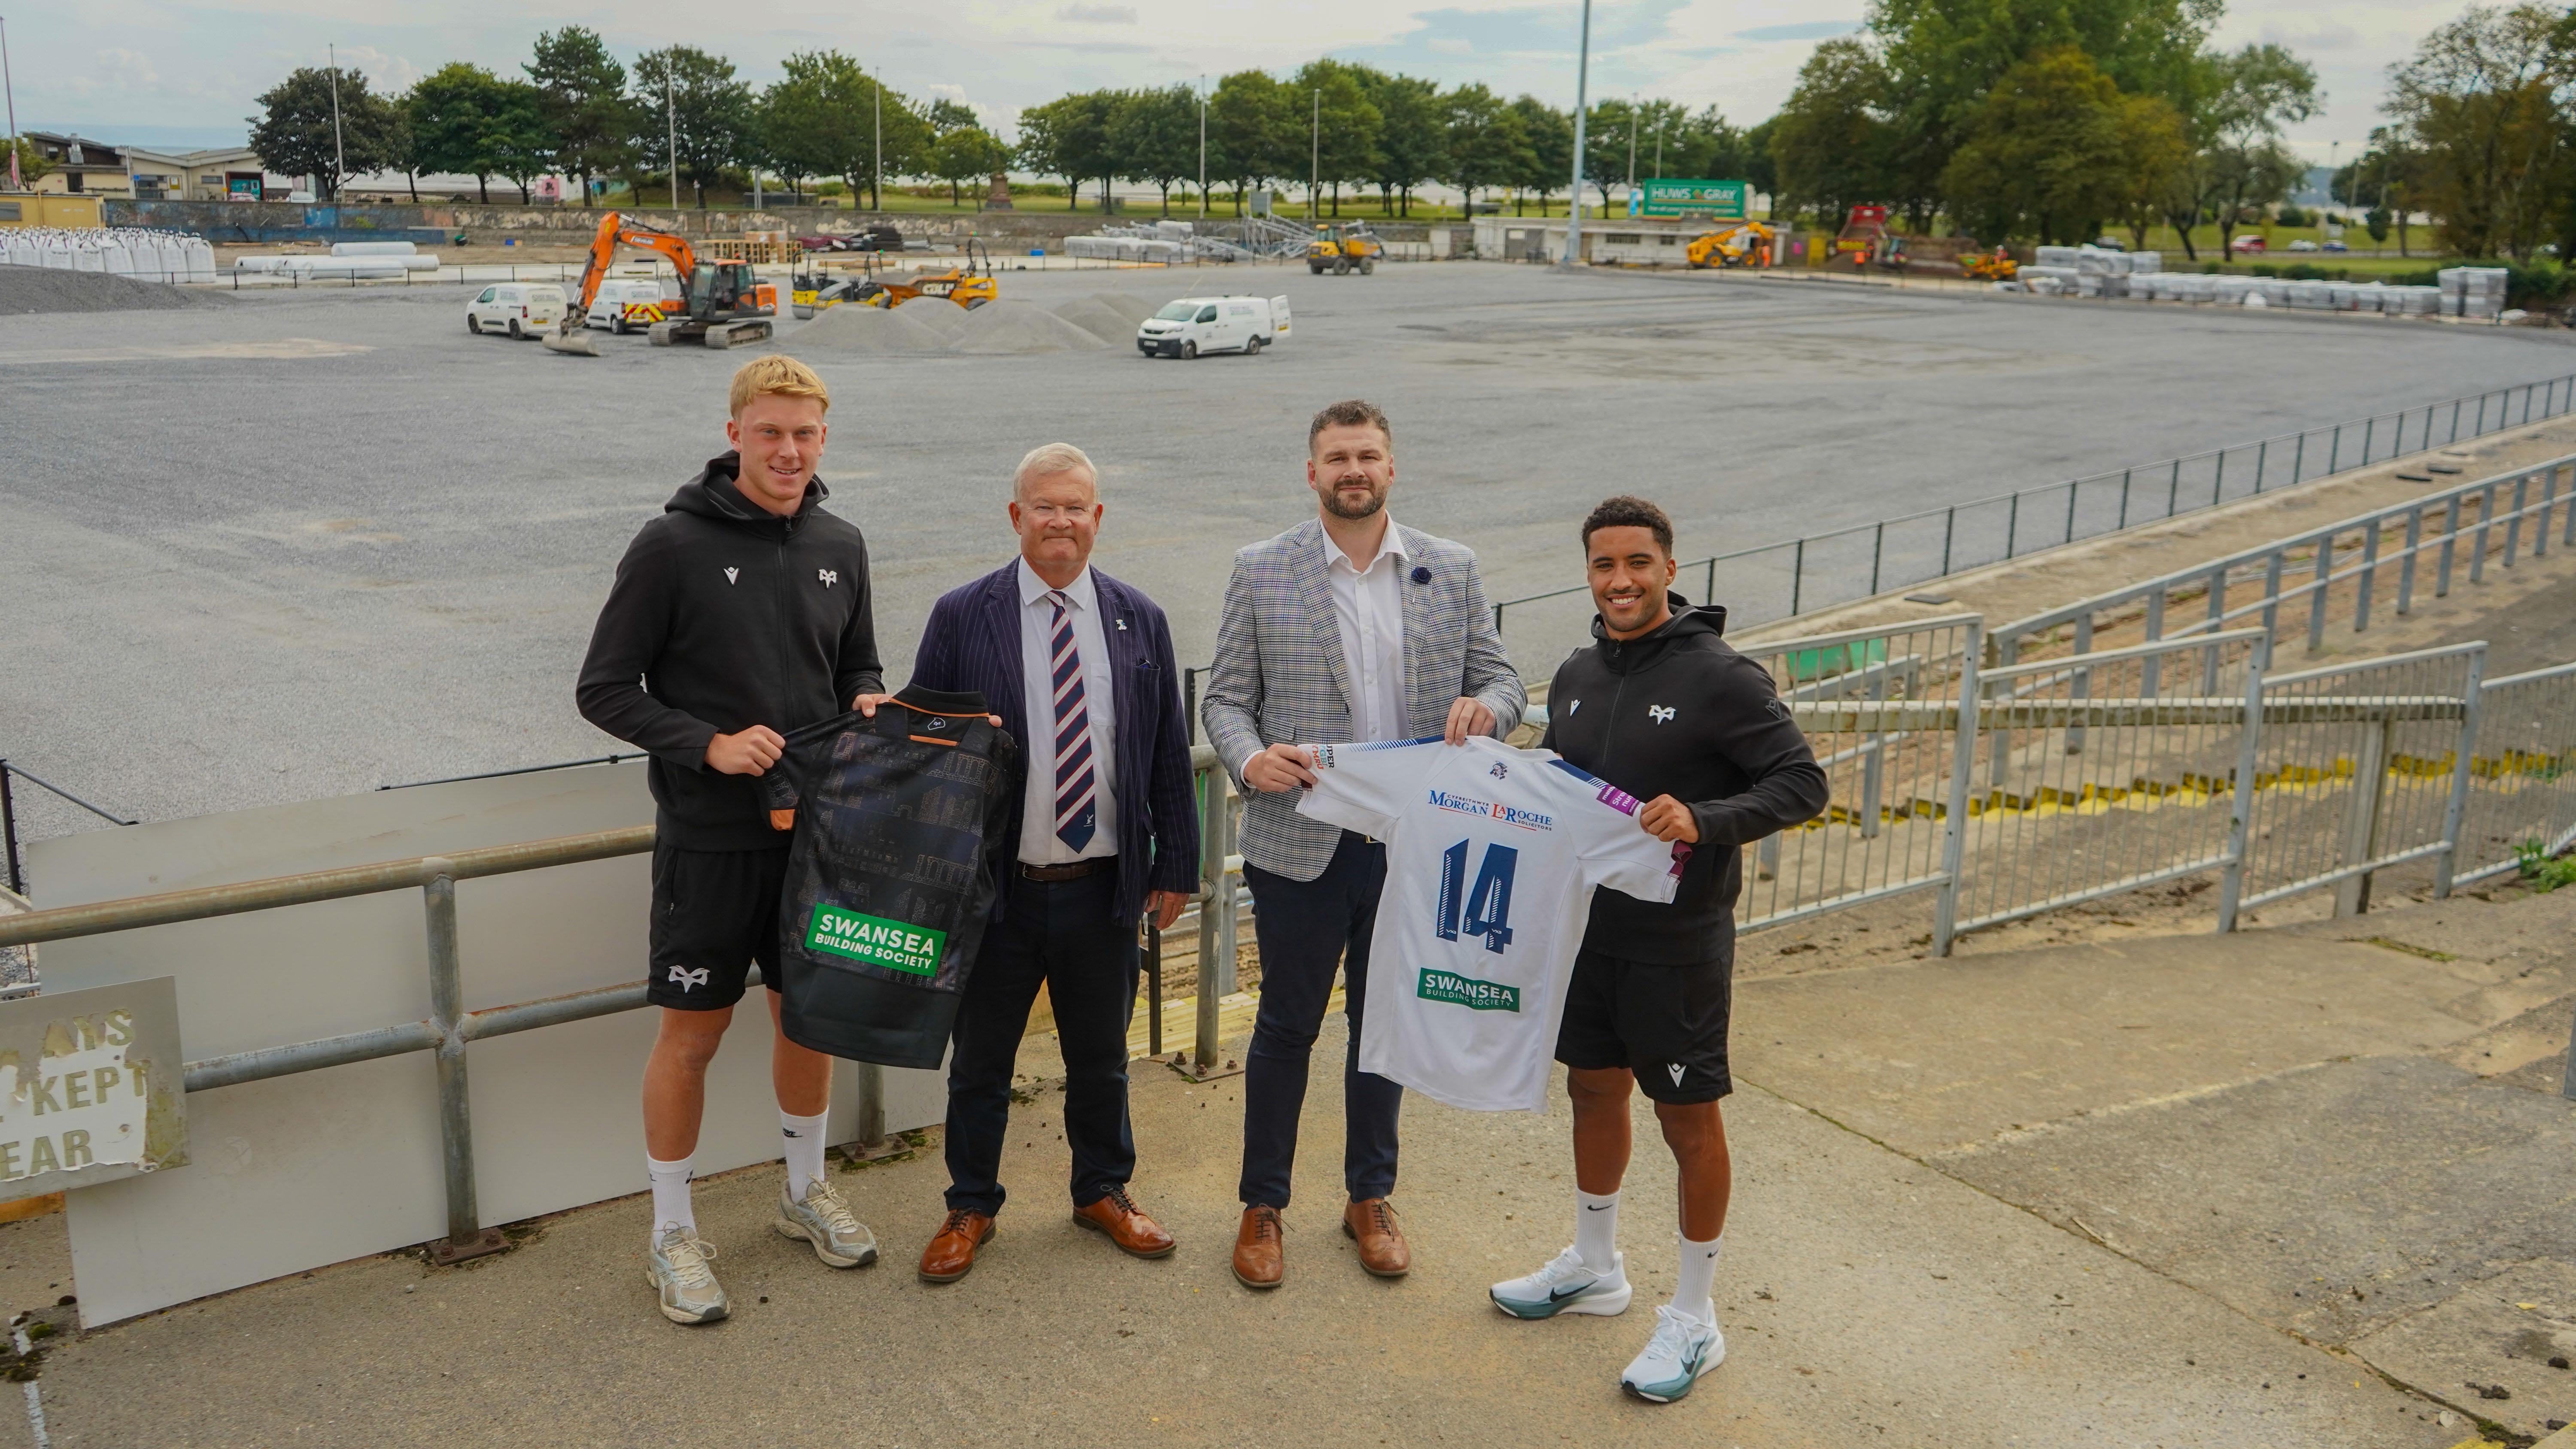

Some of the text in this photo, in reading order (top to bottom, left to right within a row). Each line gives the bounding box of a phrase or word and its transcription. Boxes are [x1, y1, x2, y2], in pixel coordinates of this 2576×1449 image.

[1653, 187, 1737, 200] HUWS GRAY
[1447, 794, 1489, 807] CYFREITHWYR
[1518, 820, 1552, 831] SOLICITORS
[1437, 838, 1518, 955] 14
[819, 914, 934, 956] SWANSEA
[815, 933, 932, 969] BUILDING SOCIETY
[1425, 974, 1514, 1003] SWANSEA
[1426, 988, 1511, 1007] BUILDING SOCIETY
[30, 1058, 151, 1116] KEPT
